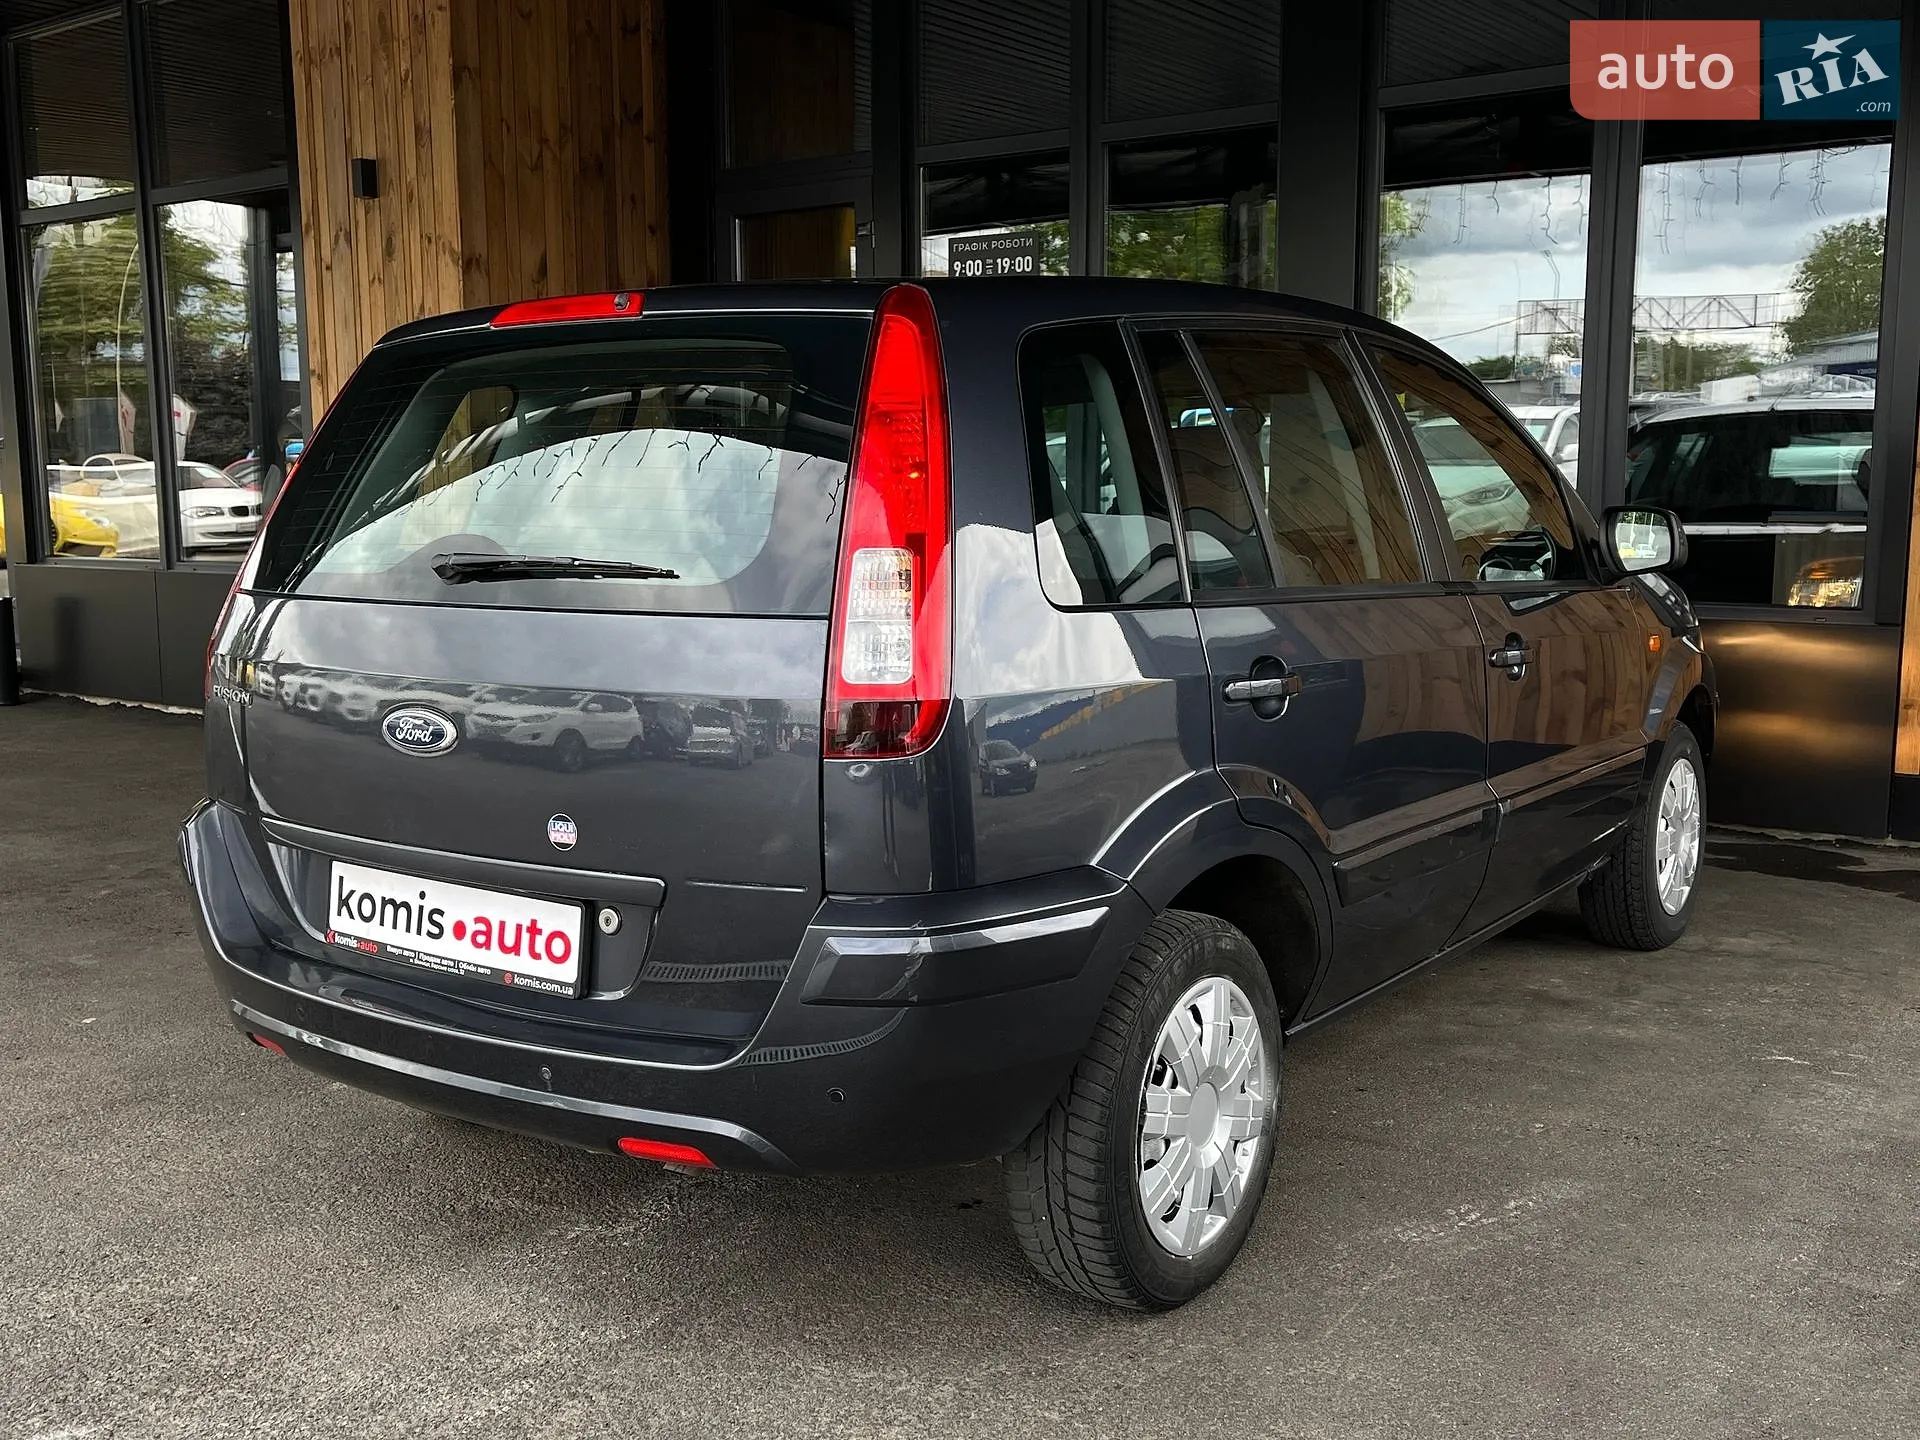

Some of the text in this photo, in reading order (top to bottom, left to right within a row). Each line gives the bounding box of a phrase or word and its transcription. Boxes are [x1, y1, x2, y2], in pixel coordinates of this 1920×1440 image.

[953, 238, 1033, 252] ГРАФІК РОБОТИ
[953, 256, 1033, 276] 9:00 19:00
[395, 716, 433, 743] Ford
[514, 974, 574, 996] komis.com.ua
